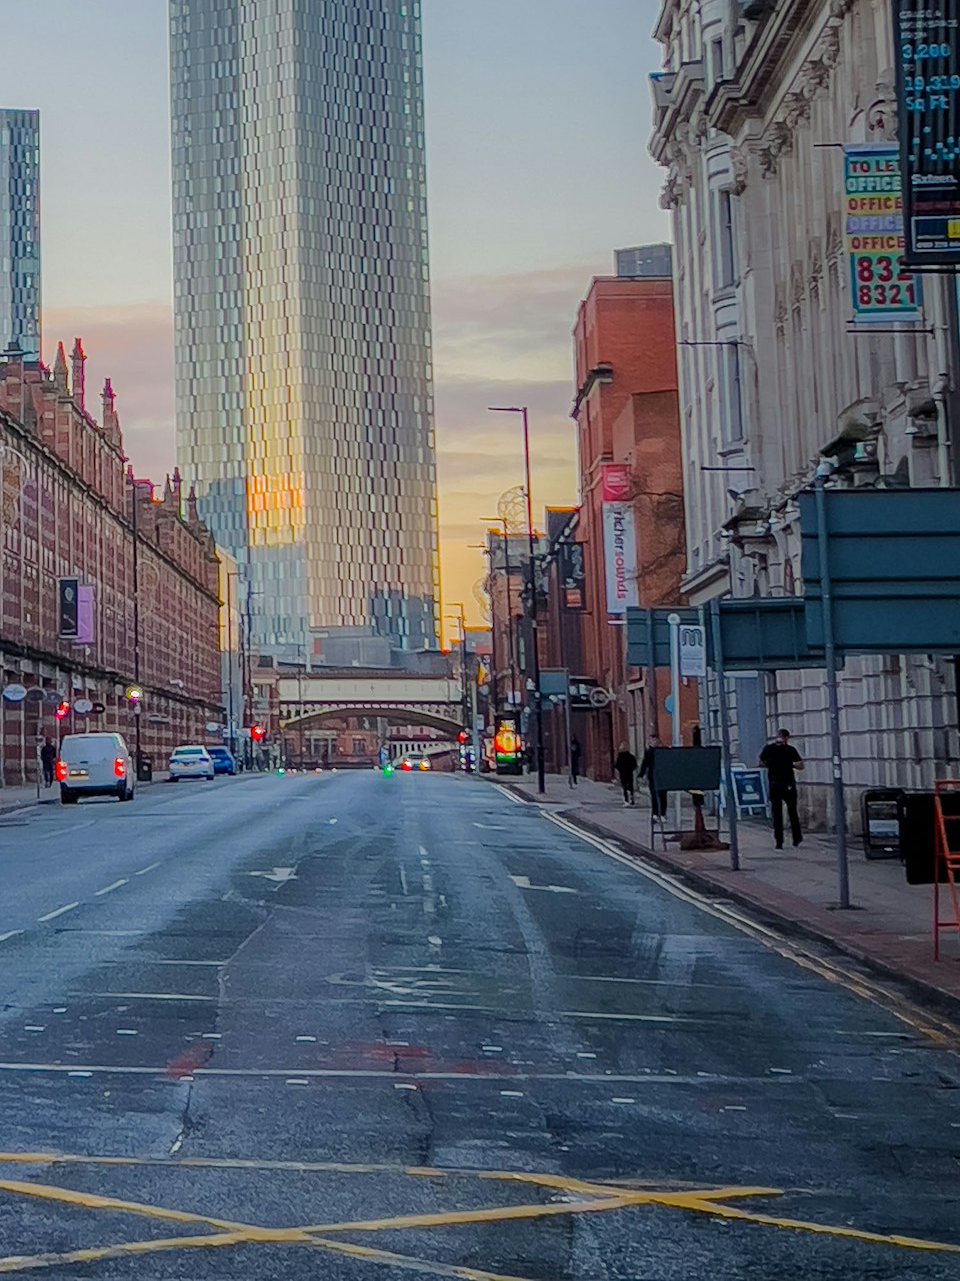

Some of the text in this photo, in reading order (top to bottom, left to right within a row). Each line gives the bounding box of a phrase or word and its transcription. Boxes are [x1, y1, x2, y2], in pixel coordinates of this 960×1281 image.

[929, 95, 950, 110] Ft
[849, 160, 871, 174] TO
[858, 283, 915, 306] 8321
